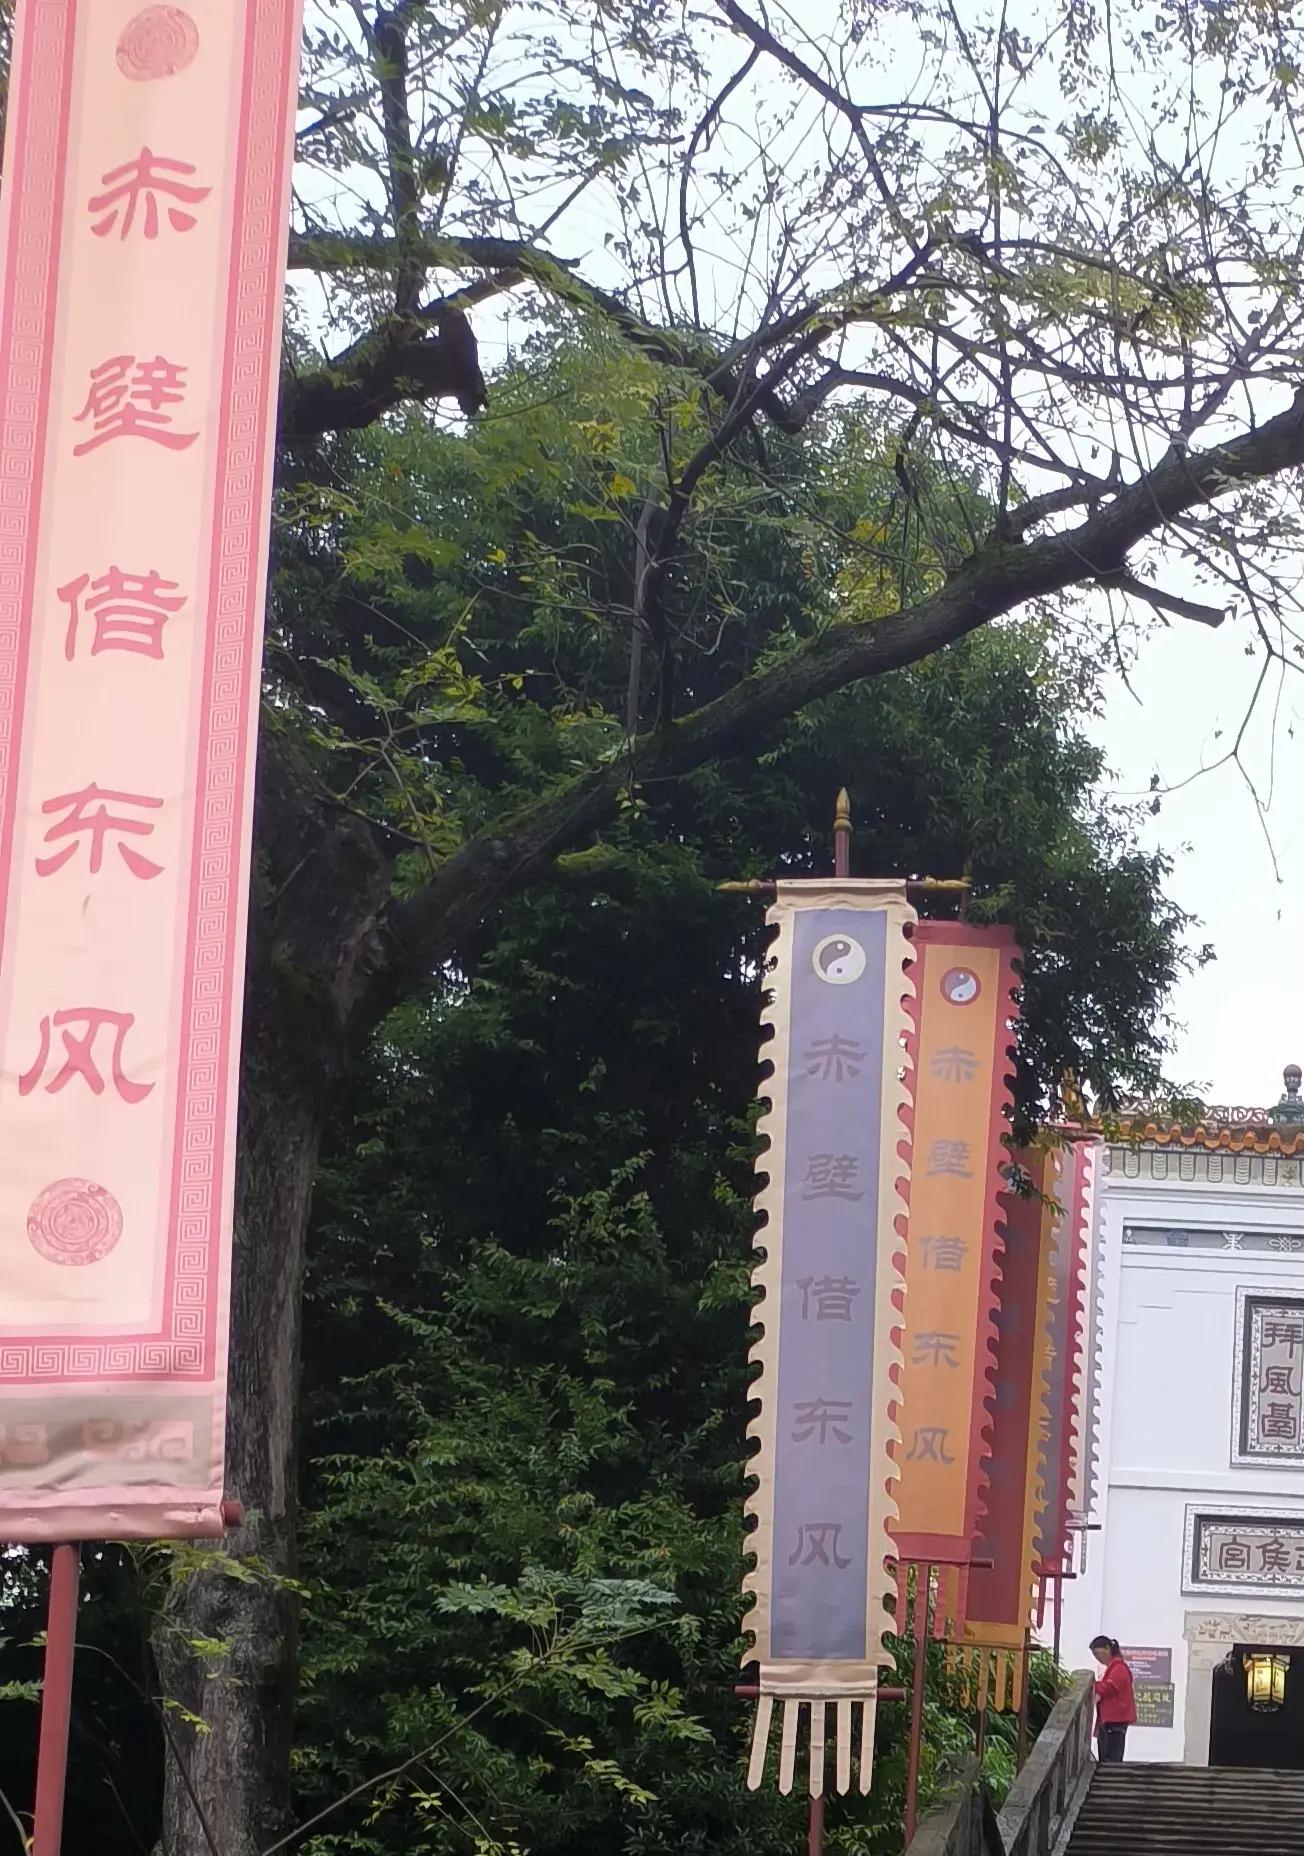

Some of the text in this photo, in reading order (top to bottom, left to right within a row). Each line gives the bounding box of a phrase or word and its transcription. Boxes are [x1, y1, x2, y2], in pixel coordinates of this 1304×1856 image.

[18, 146, 212, 1102] 赤壁借东风
[788, 1032, 867, 1570] 赤壁借东风
[904, 1045, 980, 1467] 赤壁借东风
